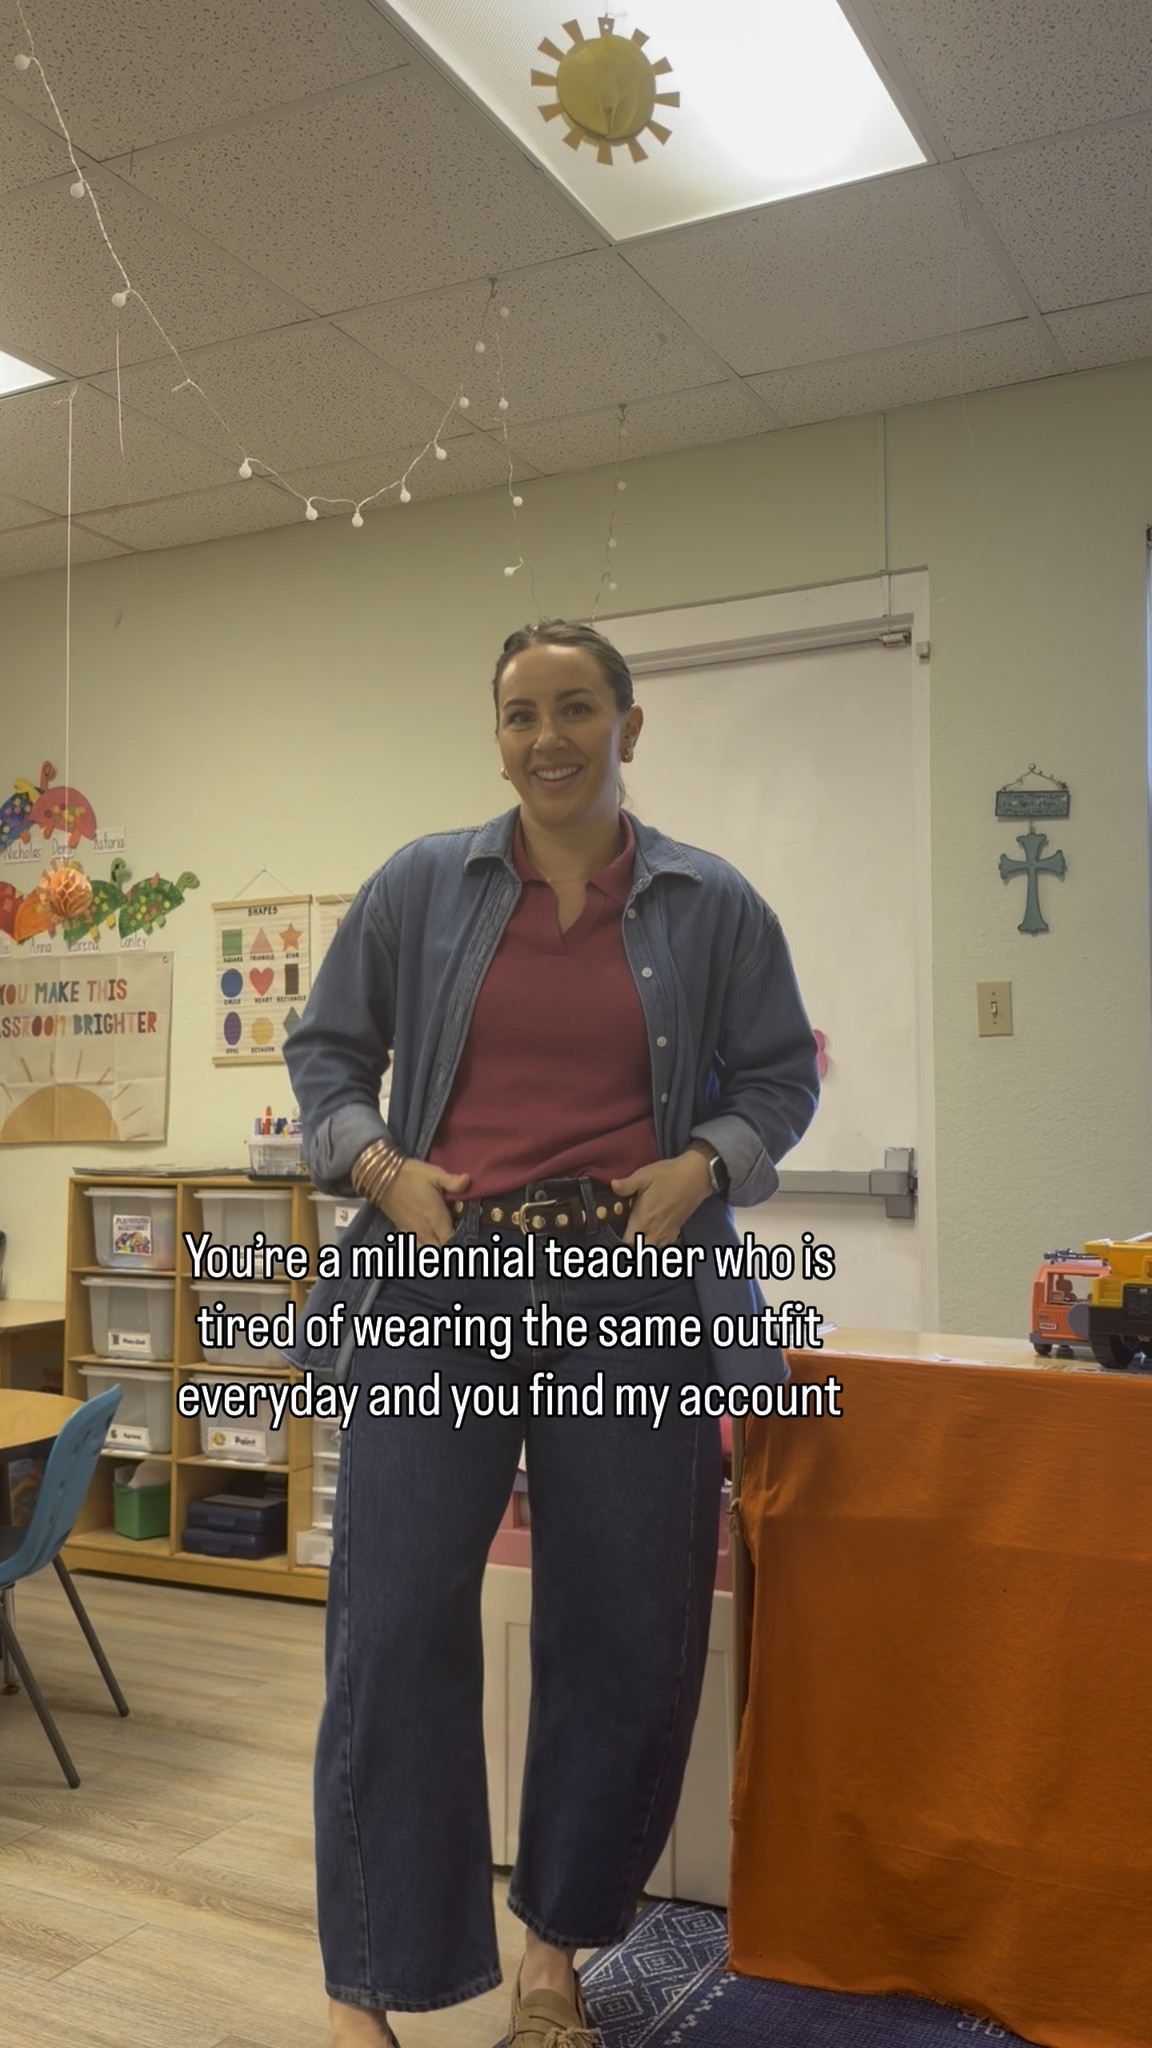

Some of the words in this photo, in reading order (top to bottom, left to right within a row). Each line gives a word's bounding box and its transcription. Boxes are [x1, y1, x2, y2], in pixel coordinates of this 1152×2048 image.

[248, 907, 278, 917] SHAPES
[0, 983, 28, 1006] YOU
[35, 981, 80, 1004] MAKE
[87, 978, 128, 1002] THIS
[277, 995, 307, 1003] RECTANGLE
[0, 1014, 66, 1038] SSROOM
[73, 1011, 158, 1036] BRIGHTER
[234, 1436, 256, 1447] Paint
